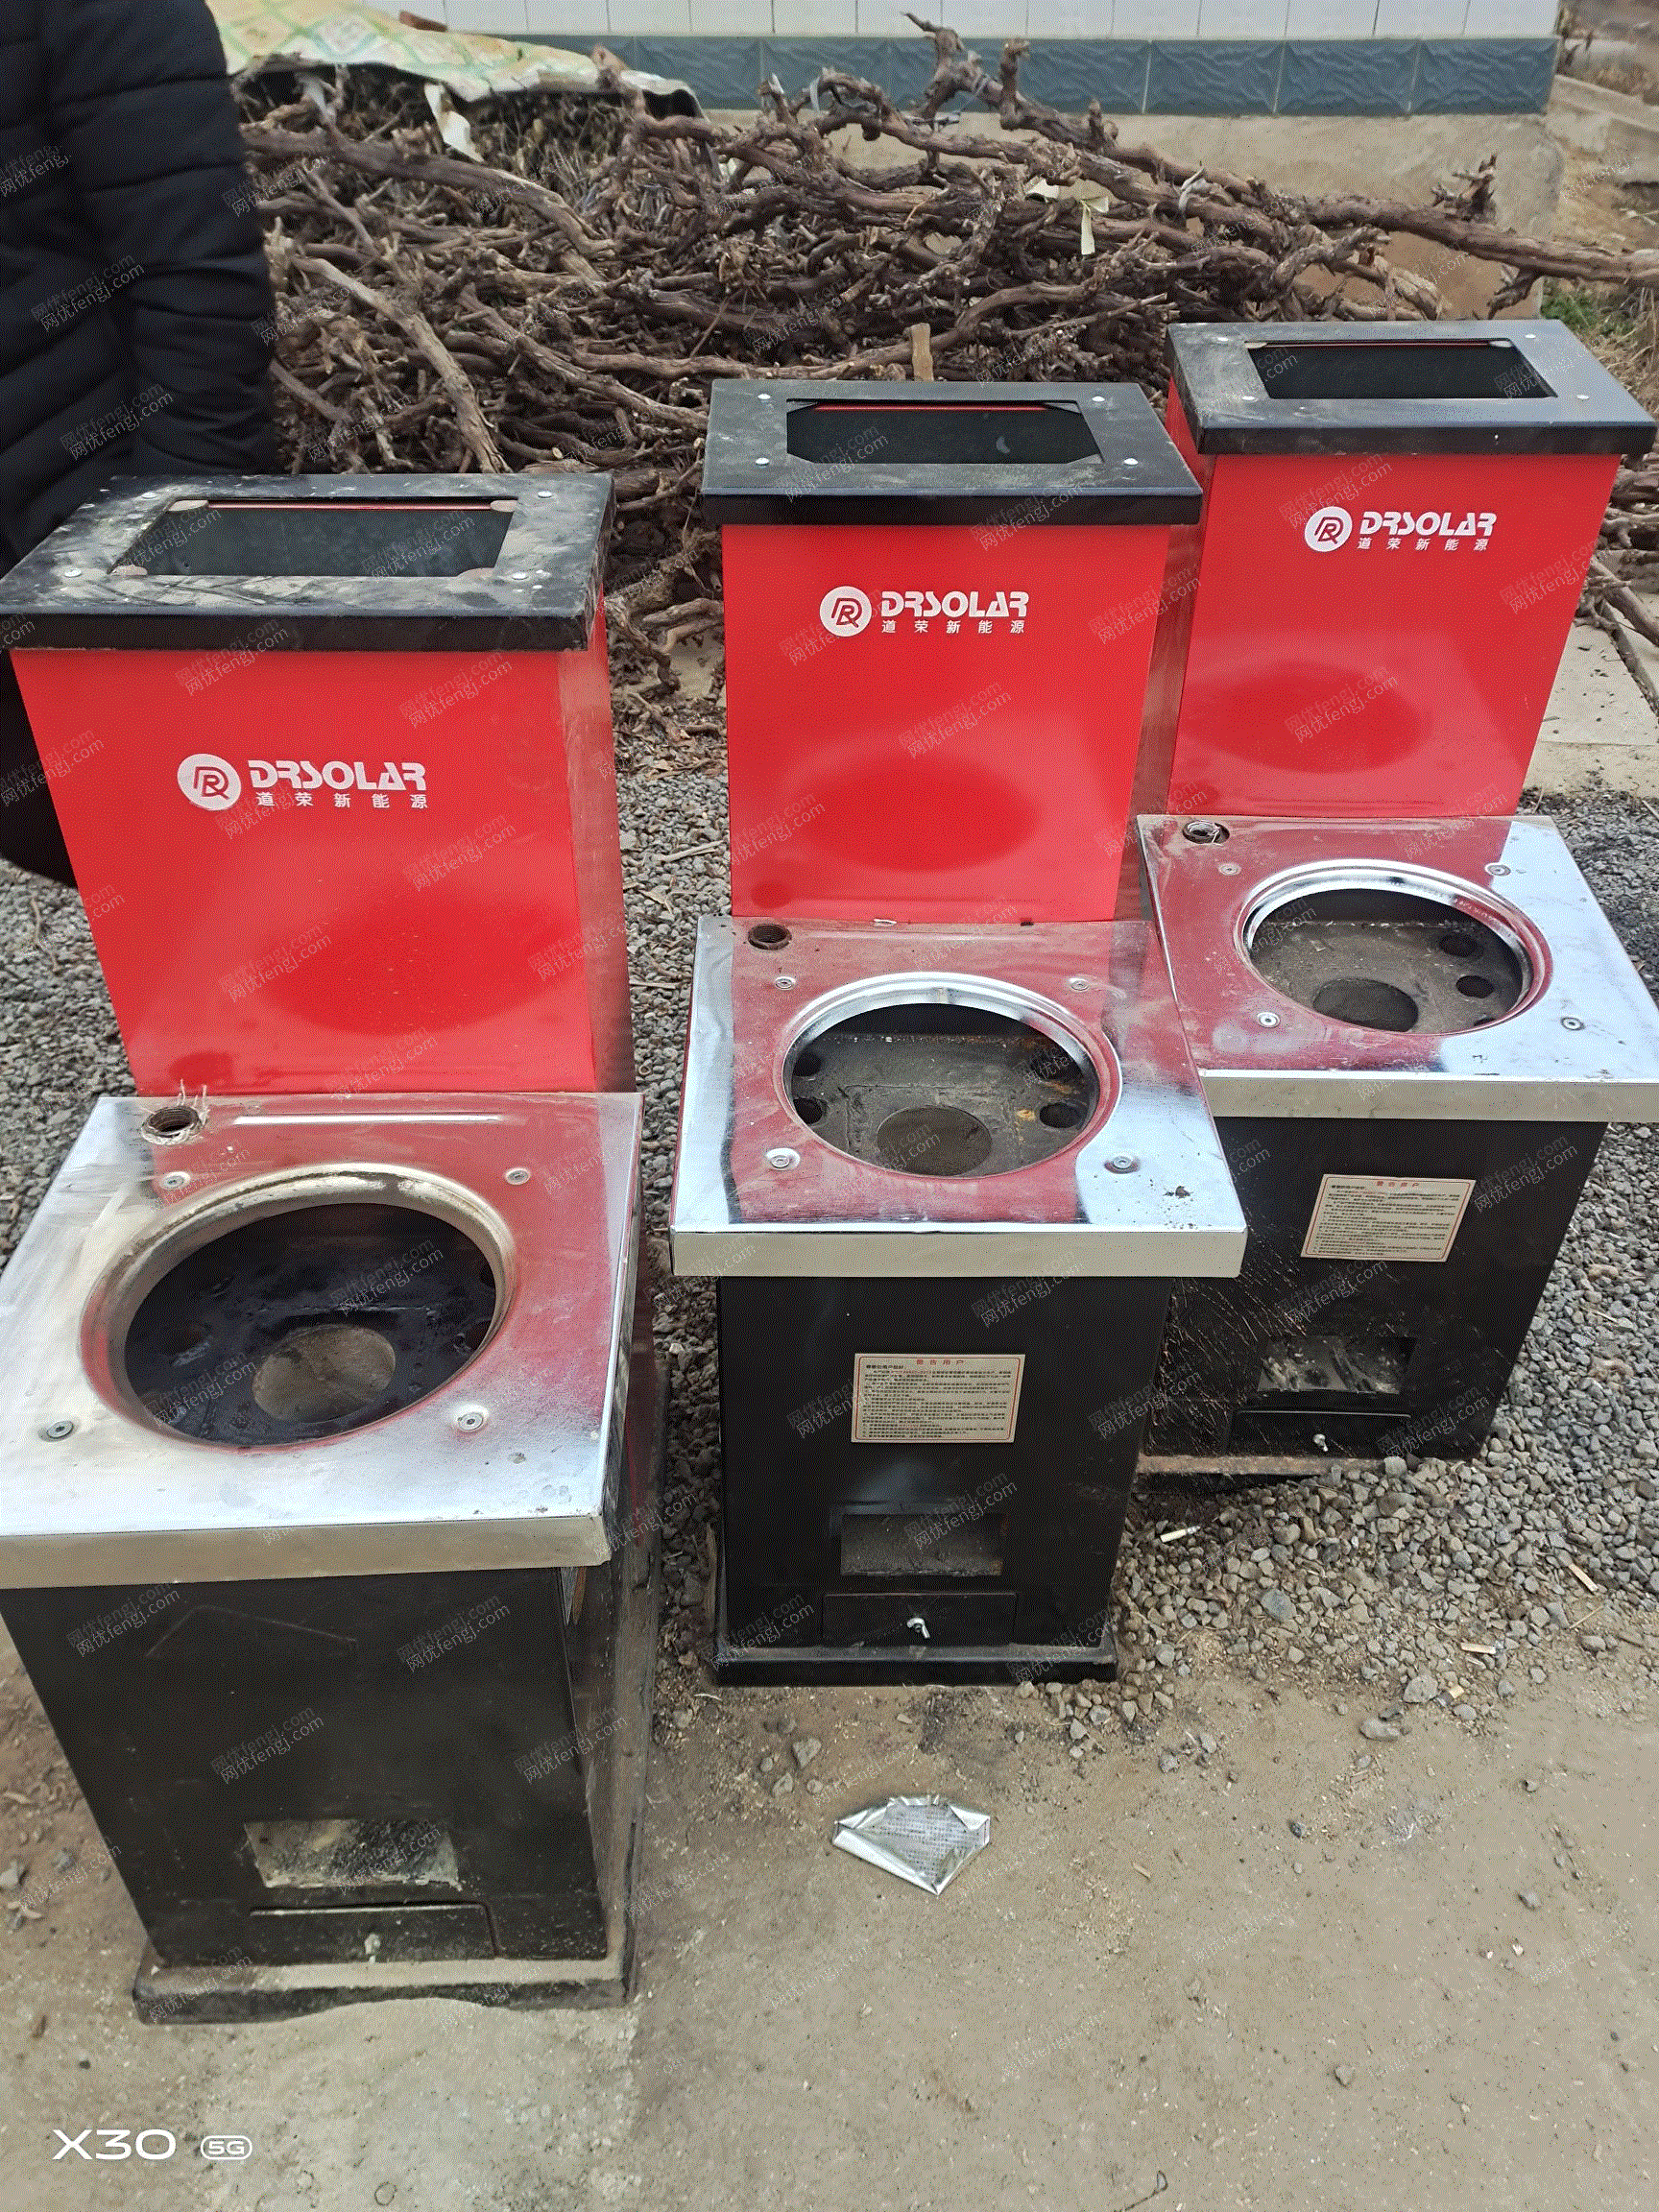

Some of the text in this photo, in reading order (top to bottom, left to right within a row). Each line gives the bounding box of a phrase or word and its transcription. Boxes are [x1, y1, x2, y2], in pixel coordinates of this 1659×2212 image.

[1359, 511, 1497, 537] DRSOLAR
[1358, 538, 1489, 551] 道荣新能源
[880, 590, 1029, 617] DRSOLAR
[881, 620, 1024, 634] 道荣新能源
[248, 759, 426, 790] DRSOLAR
[255, 792, 428, 809] 道荣新能源
